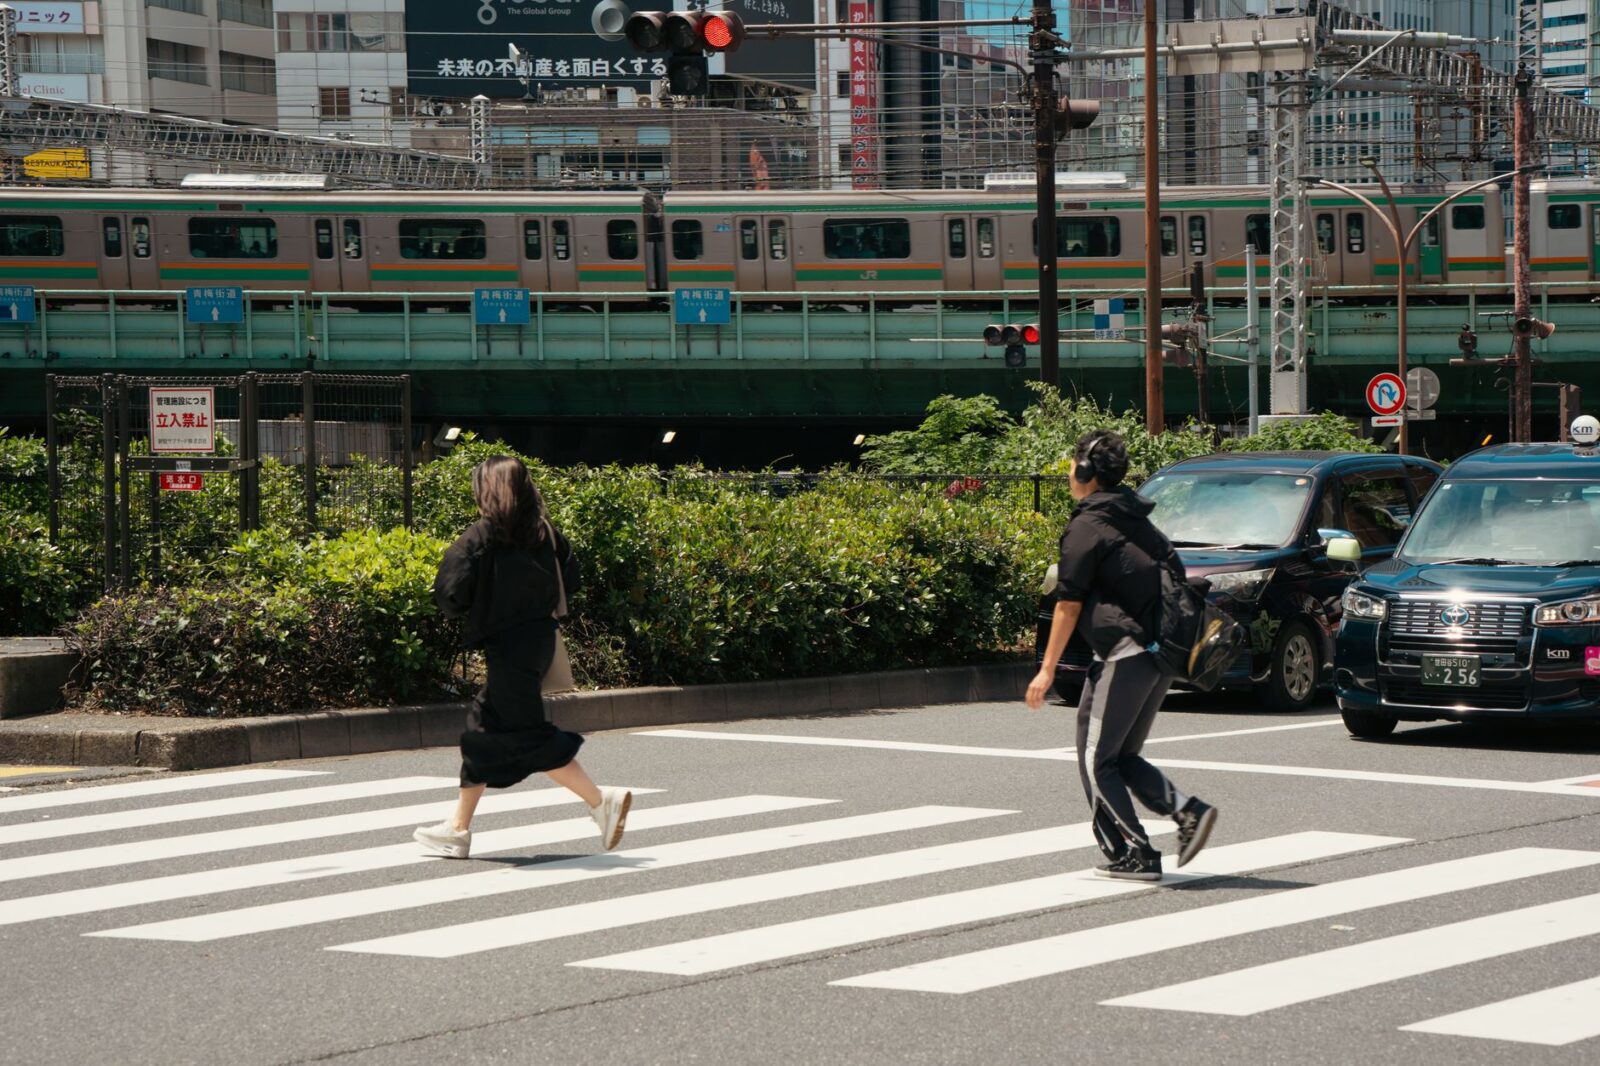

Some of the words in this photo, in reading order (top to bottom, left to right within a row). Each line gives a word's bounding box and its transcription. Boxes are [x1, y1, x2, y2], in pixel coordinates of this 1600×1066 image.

[507, 7, 521, 15] The
[522, 7, 547, 15] Global
[548, 7, 571, 15] Group
[33, 84, 65, 95] Clinic
[860, 270, 878, 280] JR
[193, 288, 236, 298] 青梅街道
[481, 290, 523, 300] 青梅街道
[682, 290, 724, 300] 青梅街道
[156, 396, 207, 406] 管理施設につき
[156, 412, 208, 428] 立入禁止
[1572, 424, 1593, 435] km
[165, 474, 197, 484] 送水口
[1547, 648, 1570, 658] km
